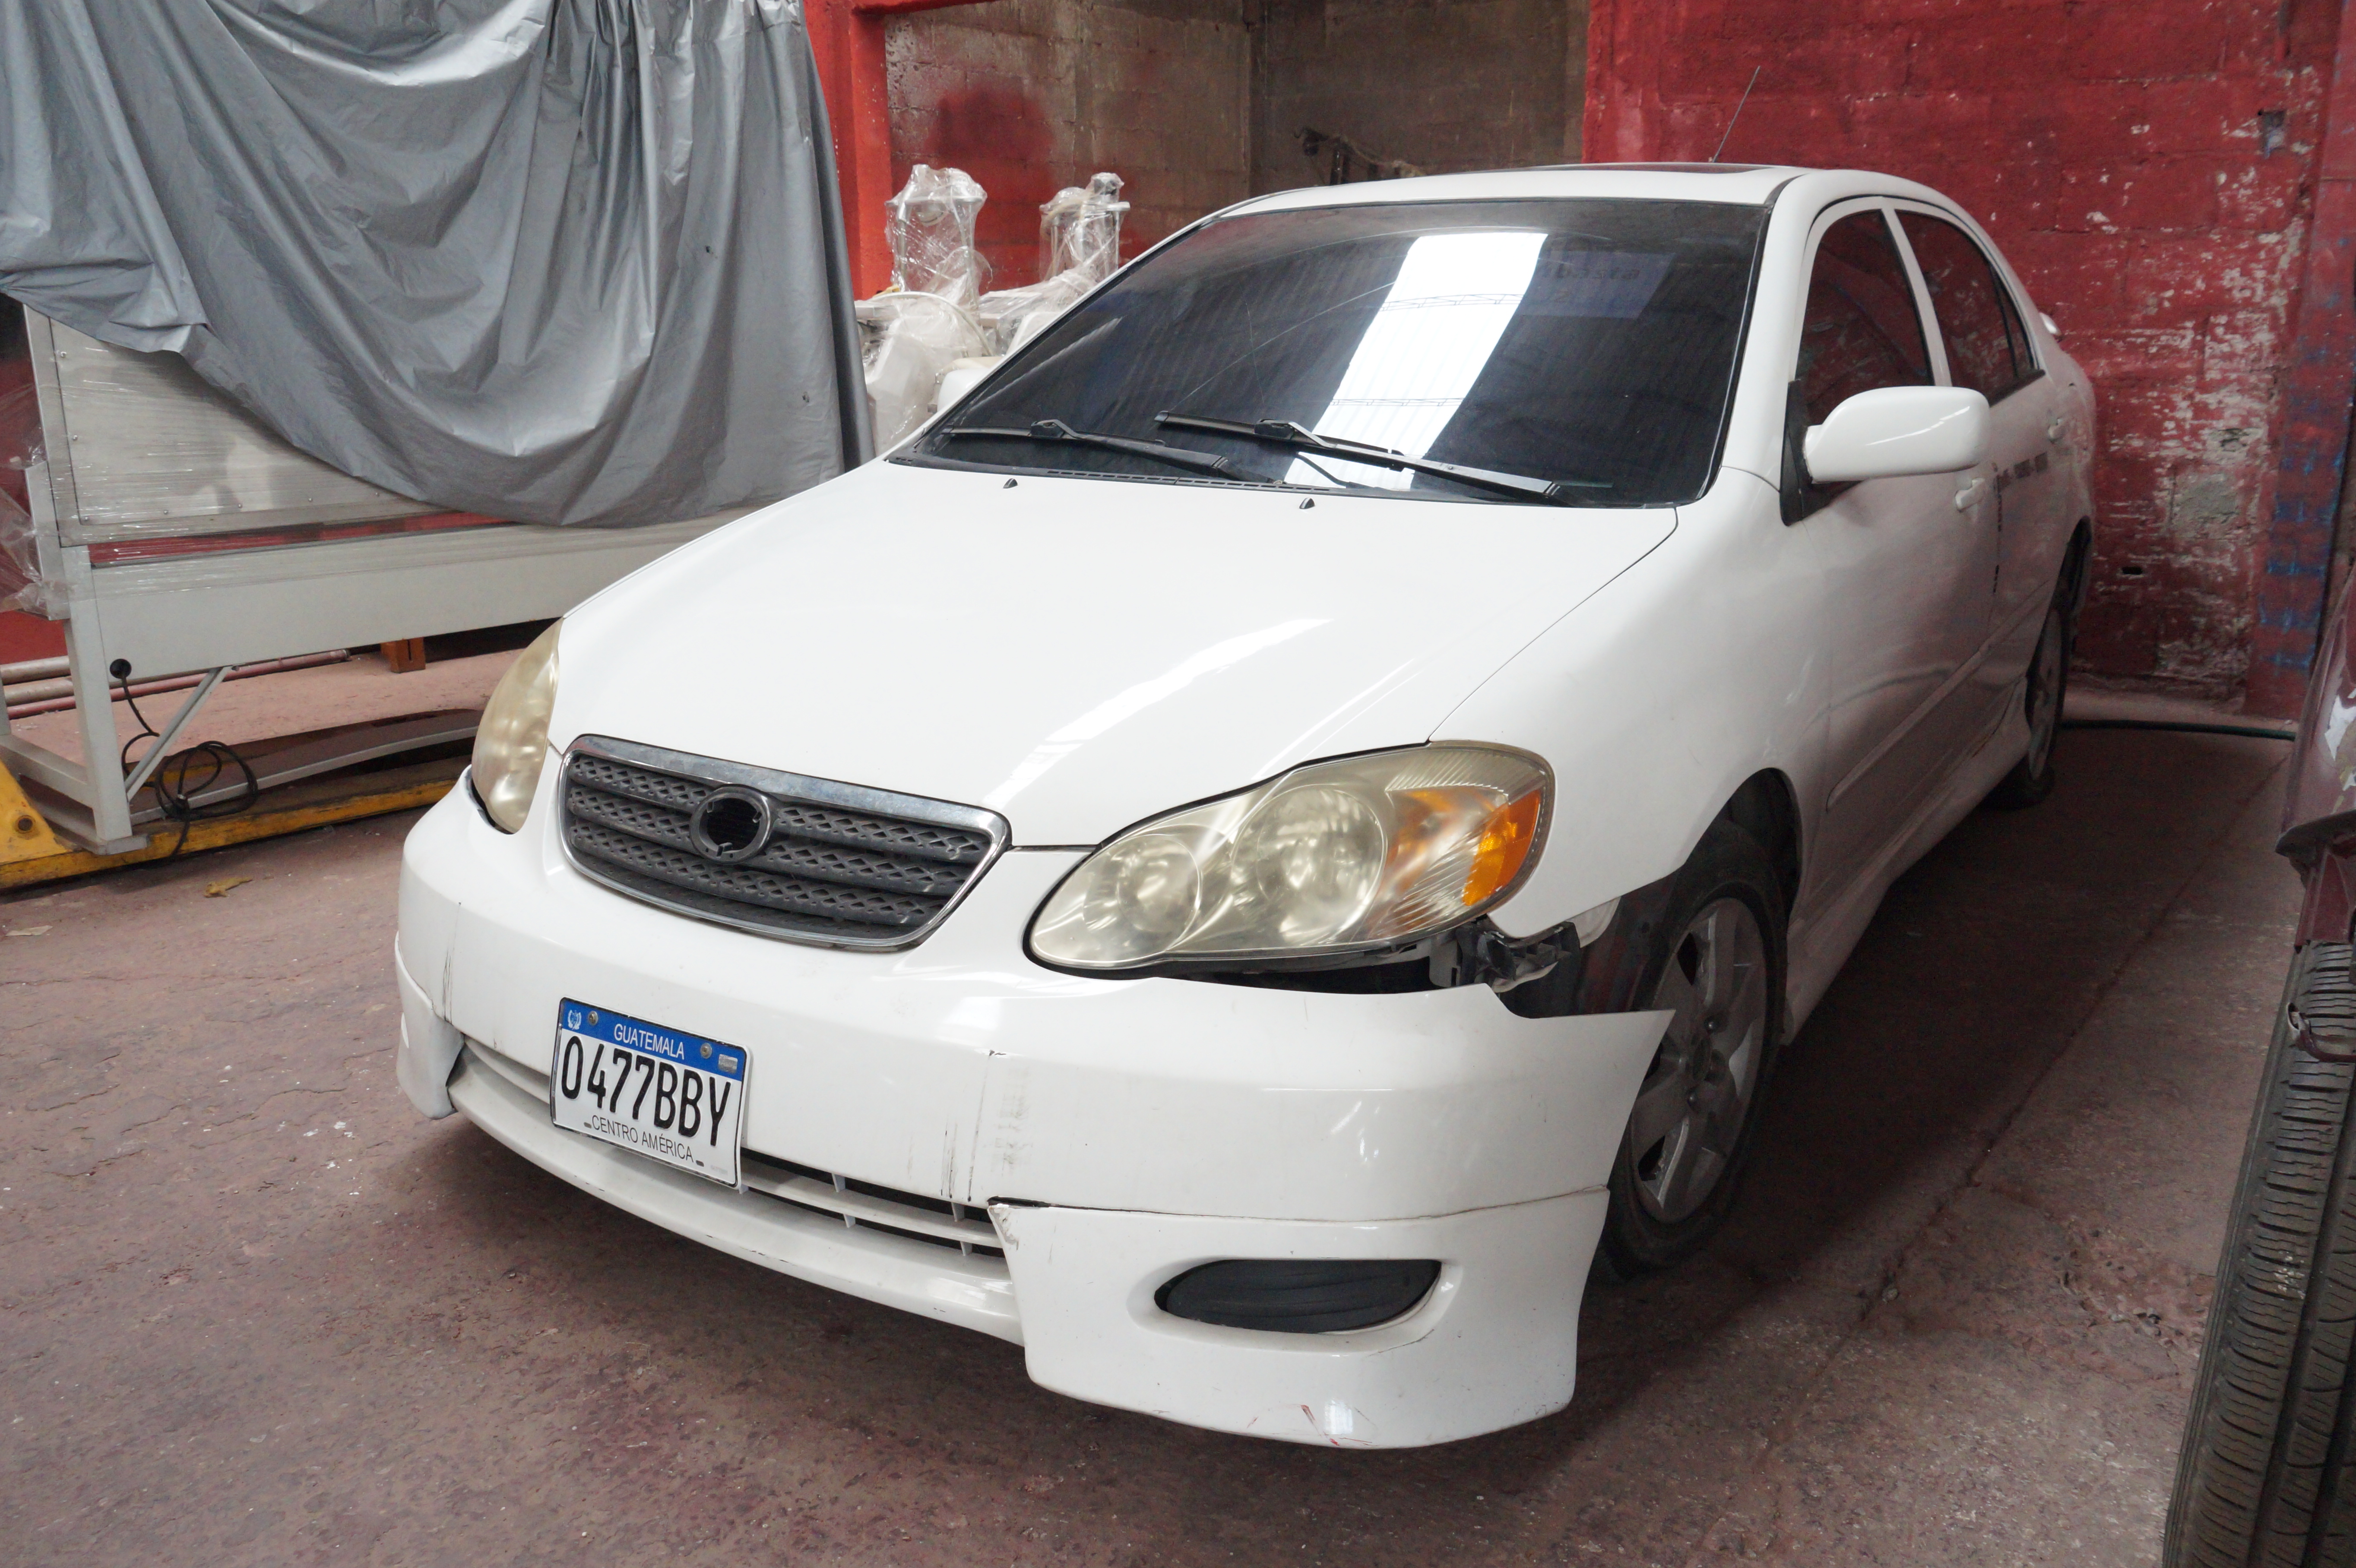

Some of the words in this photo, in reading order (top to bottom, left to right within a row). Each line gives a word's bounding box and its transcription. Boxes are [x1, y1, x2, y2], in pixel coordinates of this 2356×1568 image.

[614, 1023, 685, 1060] GUATEMALA
[592, 1114, 638, 1143] CENTRO
[641, 1131, 694, 1163] AMÉRICA
